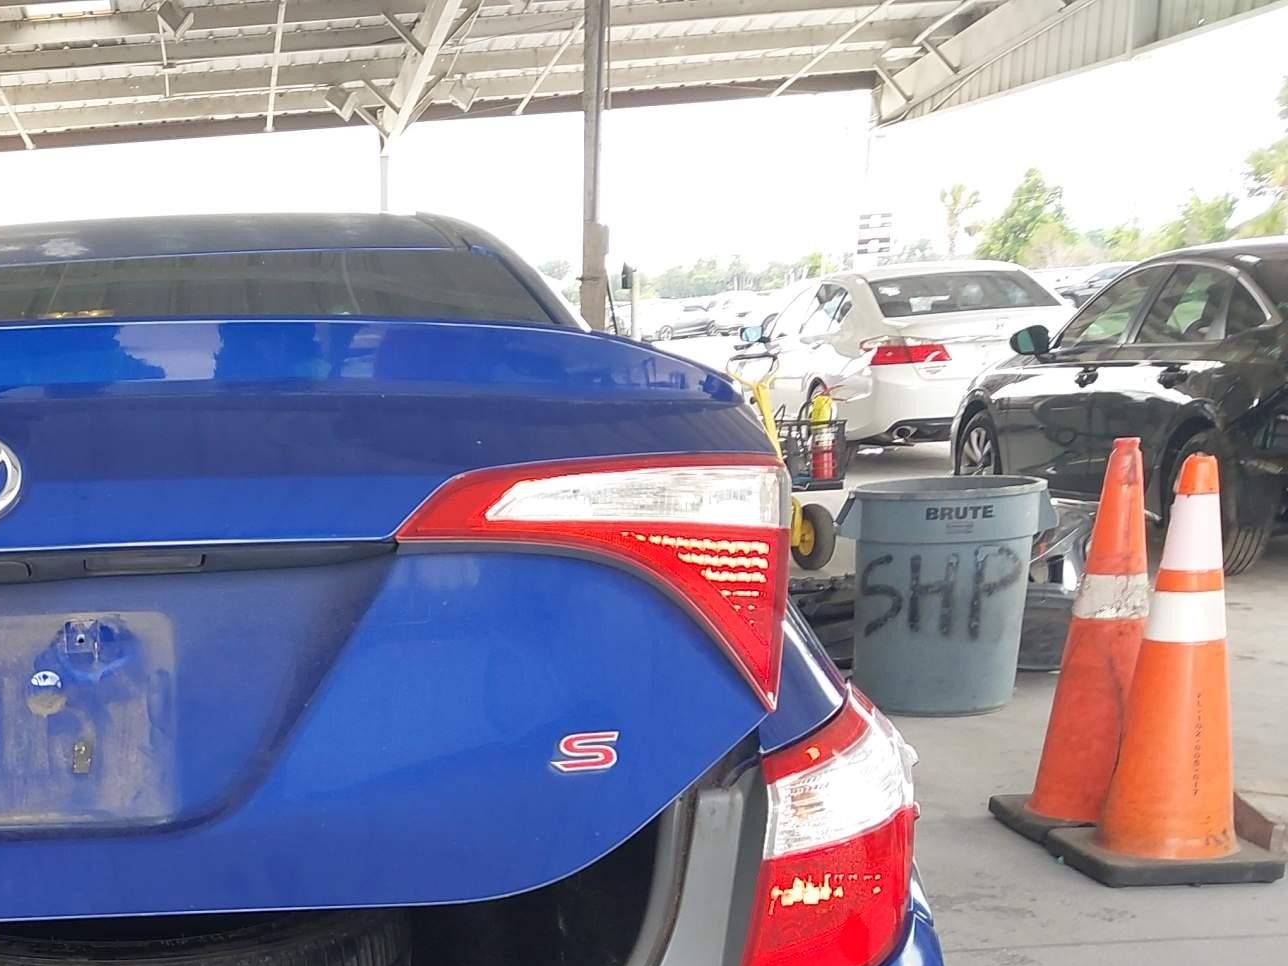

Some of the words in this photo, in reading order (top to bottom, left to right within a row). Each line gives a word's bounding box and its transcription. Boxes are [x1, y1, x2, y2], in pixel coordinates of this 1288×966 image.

[925, 504, 996, 521] BRUTE
[861, 544, 1023, 640] SHP
[550, 730, 620, 773] S
